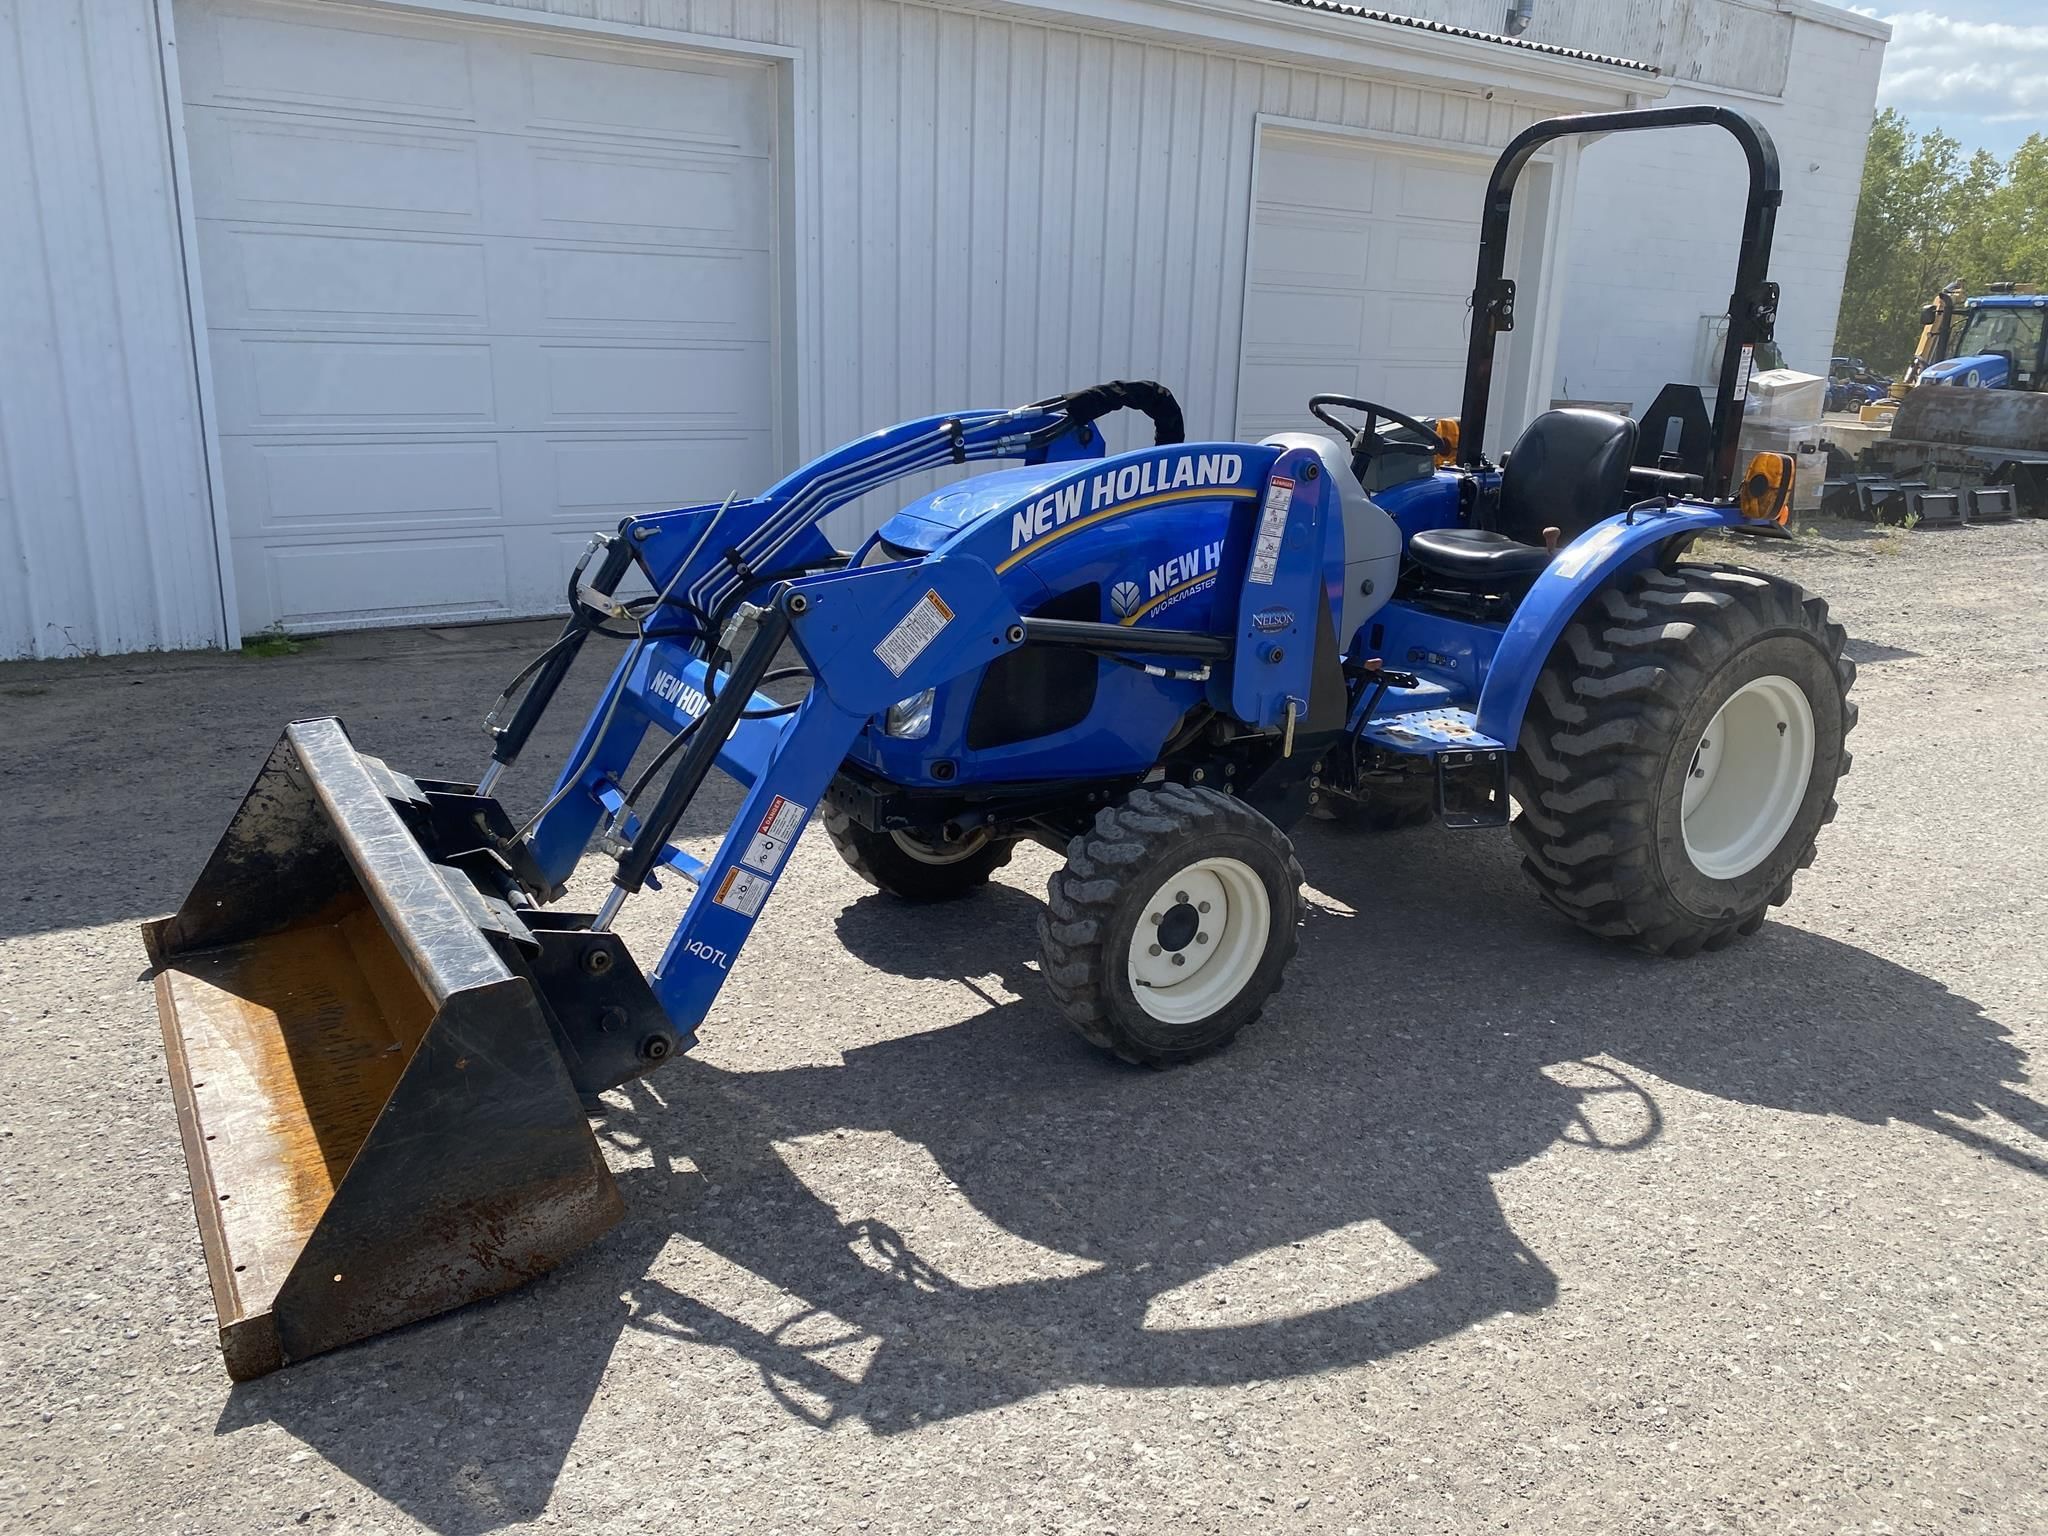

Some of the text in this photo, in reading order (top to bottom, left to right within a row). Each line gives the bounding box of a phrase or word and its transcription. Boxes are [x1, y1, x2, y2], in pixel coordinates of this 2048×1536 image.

[1011, 454, 1242, 552] NEW HOLLAND
[1149, 548, 1200, 598] NEW
[1150, 577, 1217, 618] WORKMASTER
[1252, 613, 1294, 627] NELSON
[650, 669, 685, 704] NEW
[766, 799, 783, 825] DANGER
[684, 938, 727, 970] 140TL
